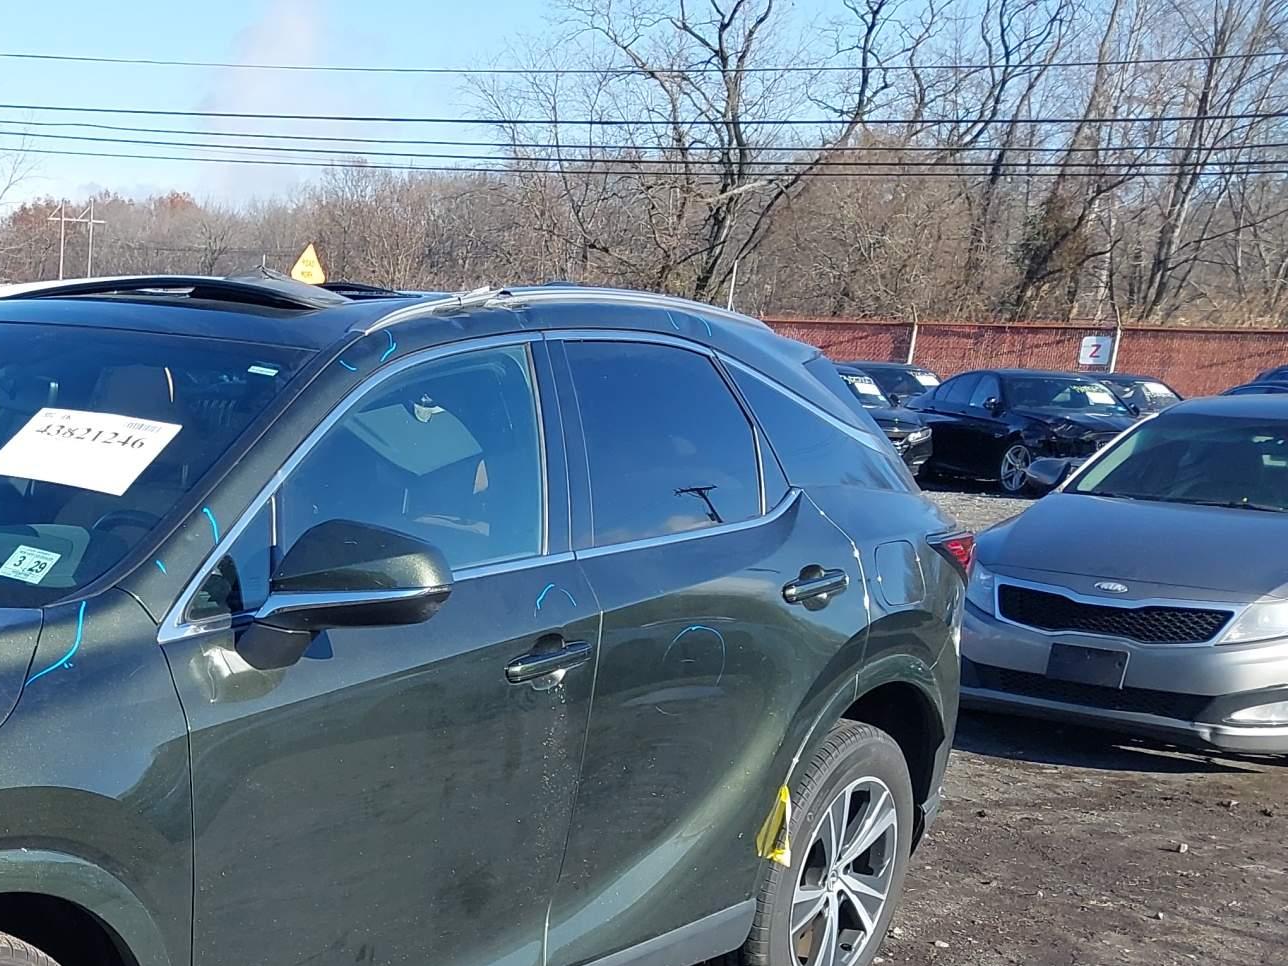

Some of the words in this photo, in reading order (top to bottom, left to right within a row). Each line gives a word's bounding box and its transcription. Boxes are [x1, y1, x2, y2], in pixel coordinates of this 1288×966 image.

[1089, 344, 1102, 358] Z
[35, 424, 145, 448] 43821246
[13, 556, 26, 567] 3
[27, 560, 48, 573] 29
